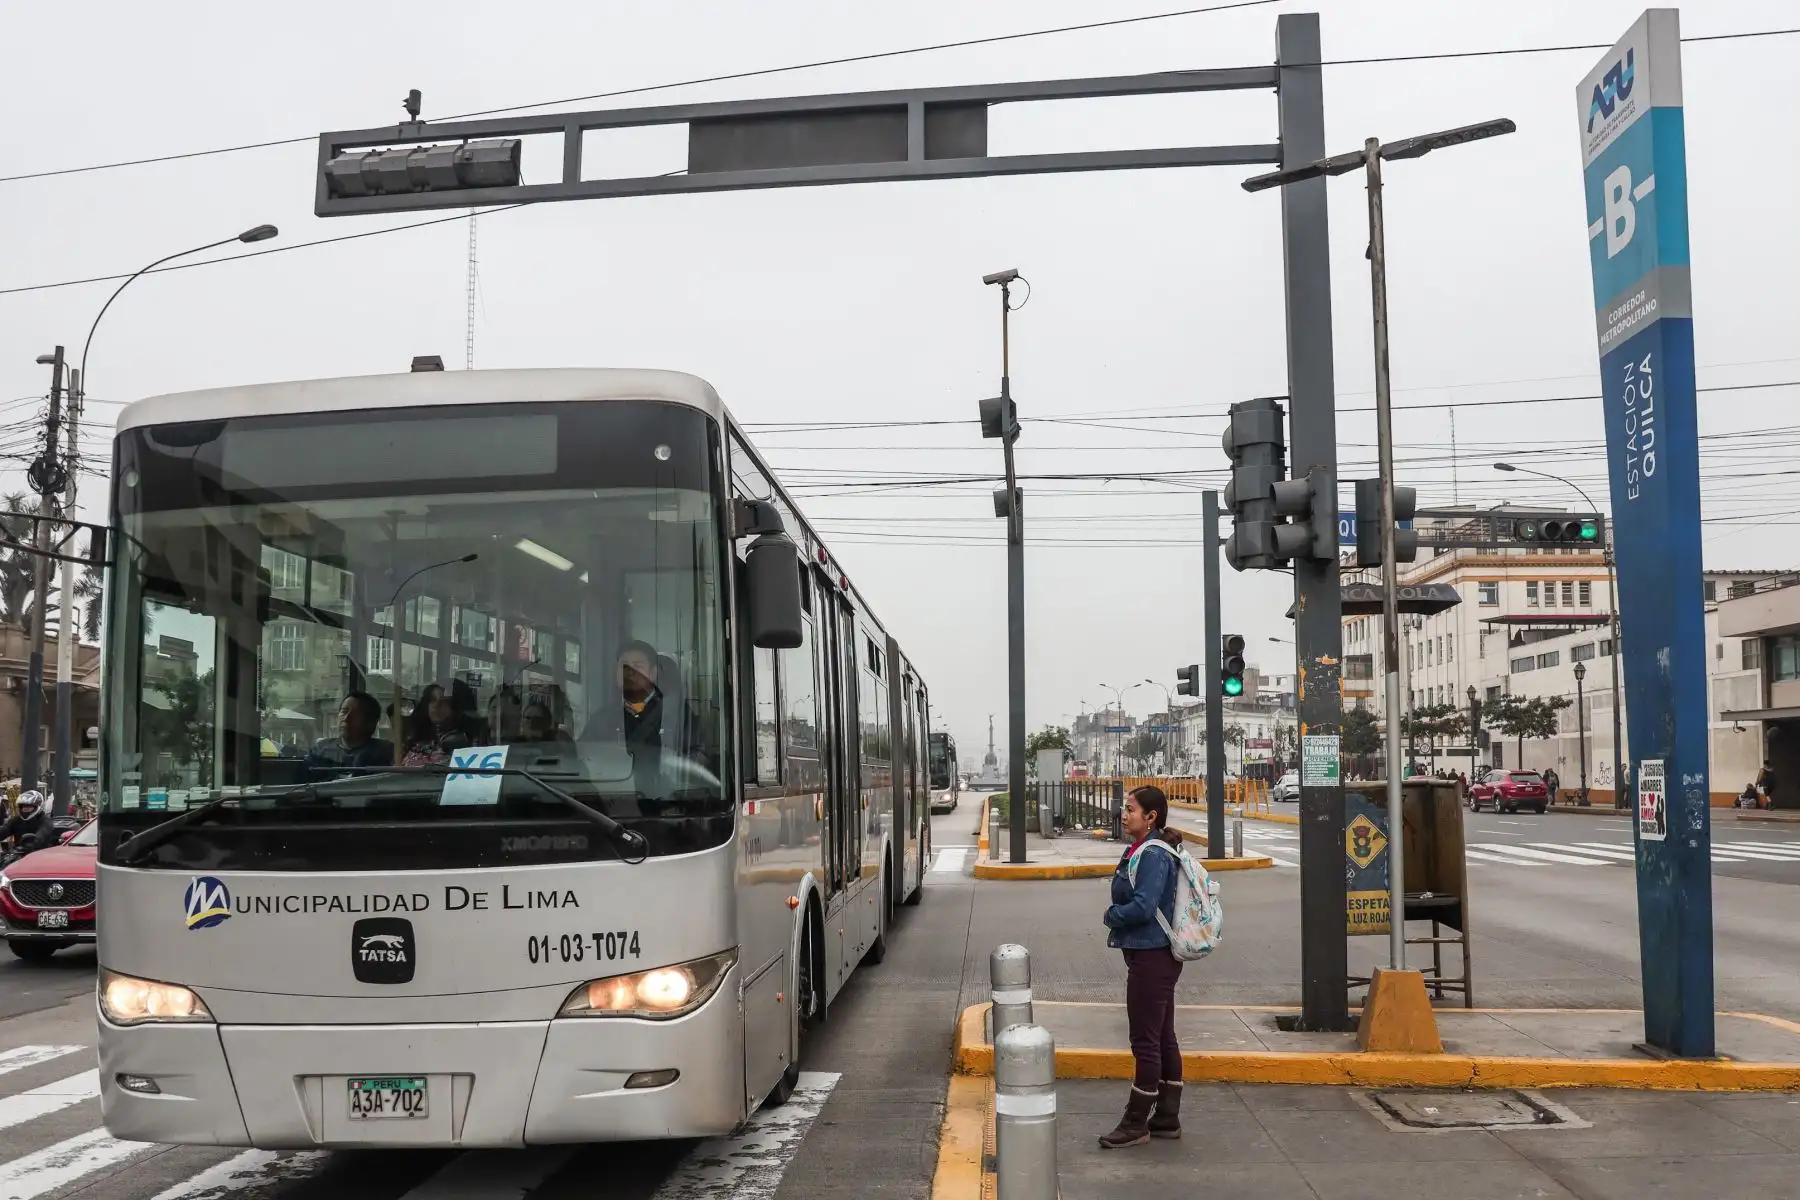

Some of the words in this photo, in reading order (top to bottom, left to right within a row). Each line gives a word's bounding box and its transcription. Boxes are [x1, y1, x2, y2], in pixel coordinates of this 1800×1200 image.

[1587, 47, 1634, 134] ATU
[1608, 289, 1645, 325] CORREDOR
[1600, 299, 1657, 347] METROPOLITANO
[1640, 353, 1656, 477] QUILCA
[1623, 362, 1639, 500] ESTACIÓN
[1341, 588, 1379, 600] NCA
[1397, 587, 1440, 600] OLA
[1305, 746, 1337, 756] TRABAJO
[448, 753, 503, 782] X6
[1641, 779, 1661, 792] AMARRES
[1641, 794, 1647, 807] DE
[1641, 808, 1655, 821] AMOR
[1348, 898, 1390, 910] ESPETA
[1353, 912, 1368, 924] LUZ
[1370, 912, 1391, 924] ROJA
[359, 949, 407, 963] TATSA
[528, 930, 641, 964] 01-03-T074
[352, 1089, 423, 1112] A3A-702
